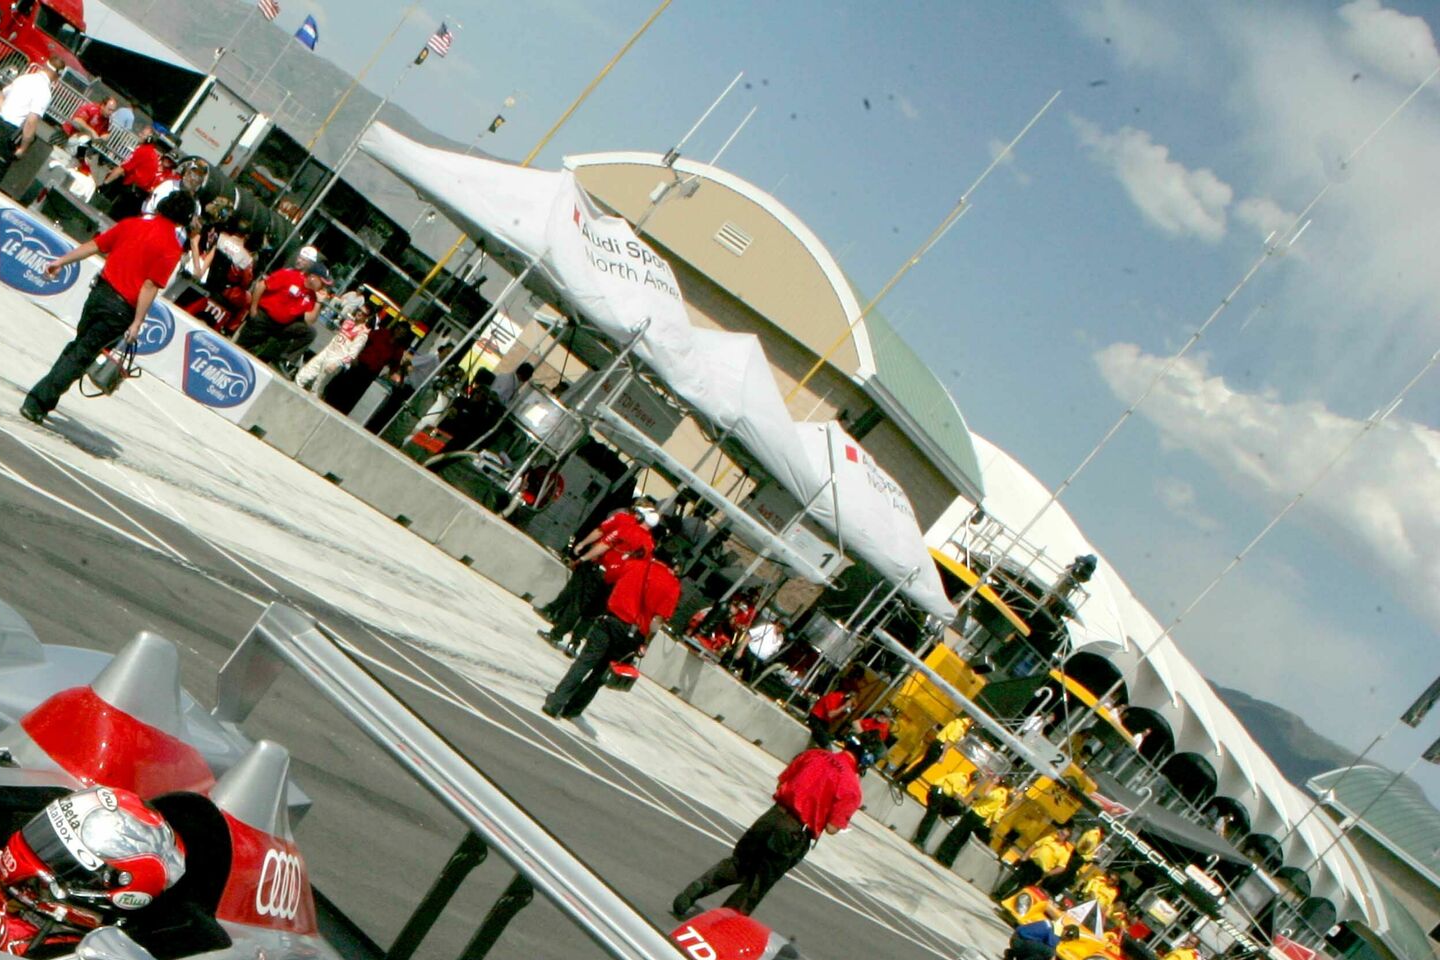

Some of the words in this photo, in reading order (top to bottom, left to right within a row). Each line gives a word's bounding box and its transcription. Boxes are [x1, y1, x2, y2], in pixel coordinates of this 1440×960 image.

[1, 209, 35, 235] American
[582, 223, 621, 254] Audi
[1, 238, 22, 256] LE
[16, 246, 49, 274] MANS
[585, 246, 638, 283] North
[190, 357, 207, 373] LE
[820, 553, 834, 569] 1
[1098, 810, 1188, 885] PORSCHE
